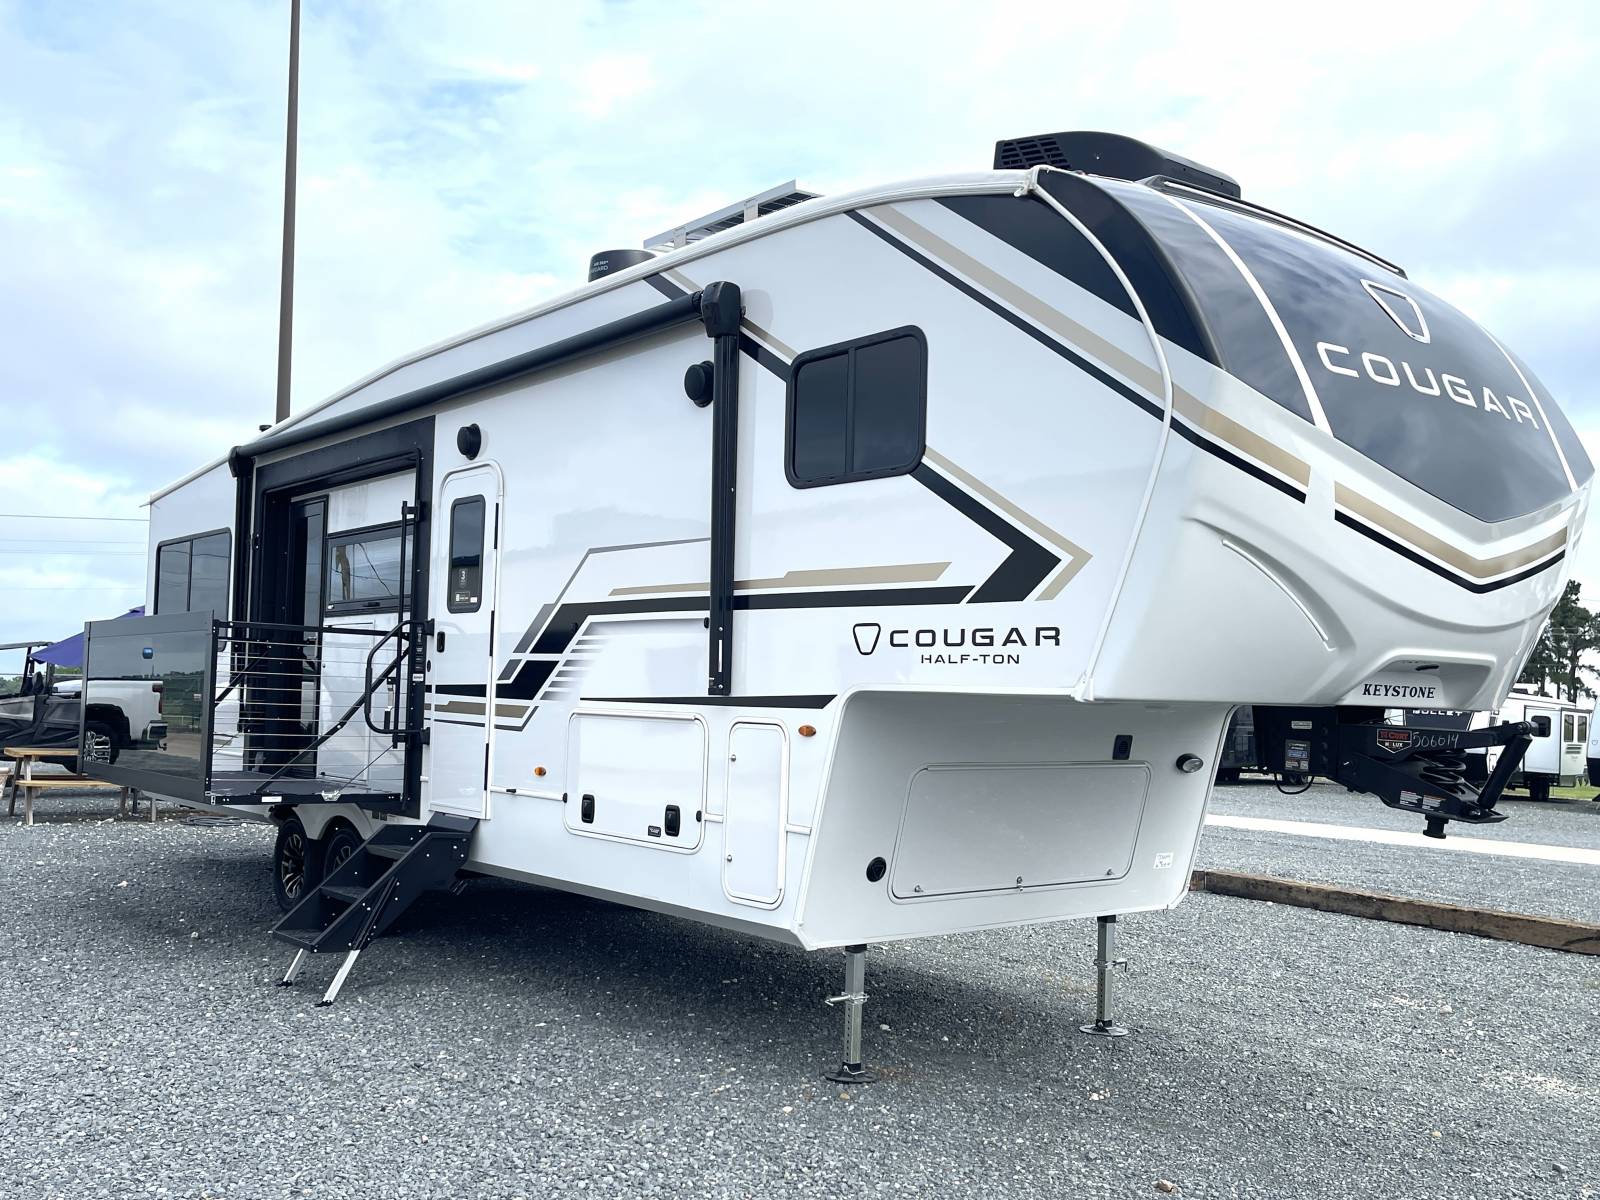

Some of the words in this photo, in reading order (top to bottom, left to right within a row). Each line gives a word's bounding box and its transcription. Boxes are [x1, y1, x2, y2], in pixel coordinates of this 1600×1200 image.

[1316, 341, 1540, 430] COUGAR
[889, 626, 1061, 648] COUGAR
[920, 653, 1021, 665] HALF-TON
[1362, 683, 1436, 698] KEYSTONE
[1413, 731, 1460, 748] 506014
